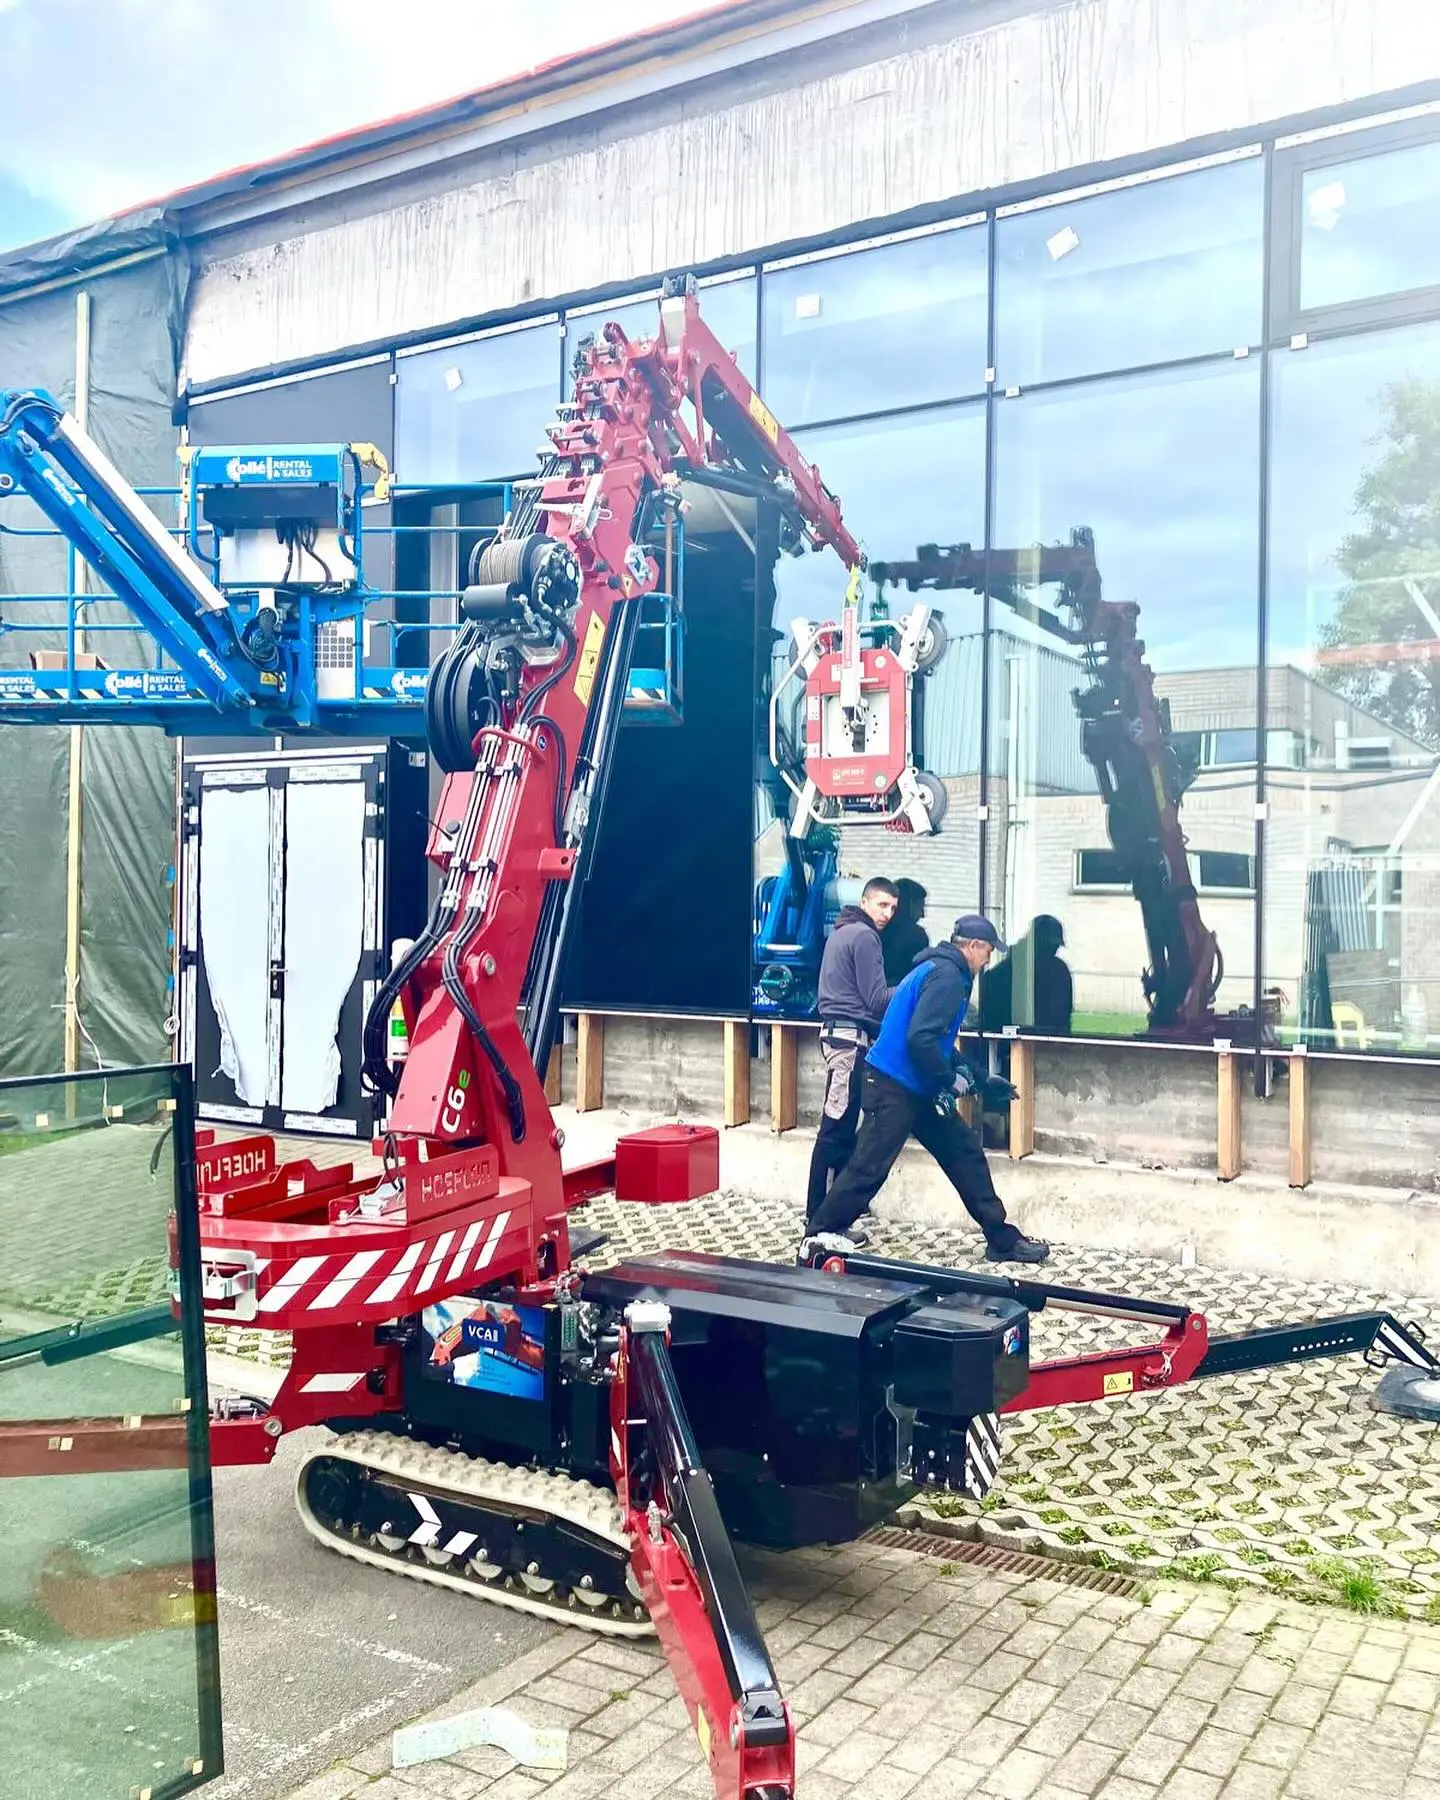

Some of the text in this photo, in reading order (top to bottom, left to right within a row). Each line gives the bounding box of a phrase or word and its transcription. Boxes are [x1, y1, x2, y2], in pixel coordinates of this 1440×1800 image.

[226, 456, 265, 482] Collé
[273, 460, 312, 470] RENTAL
[273, 470, 312, 480] & SALES
[105, 672, 142, 697] Collé
[150, 676, 186, 684] RENTAL
[158, 684, 186, 692] SALES
[441, 1069, 471, 1133] C6e
